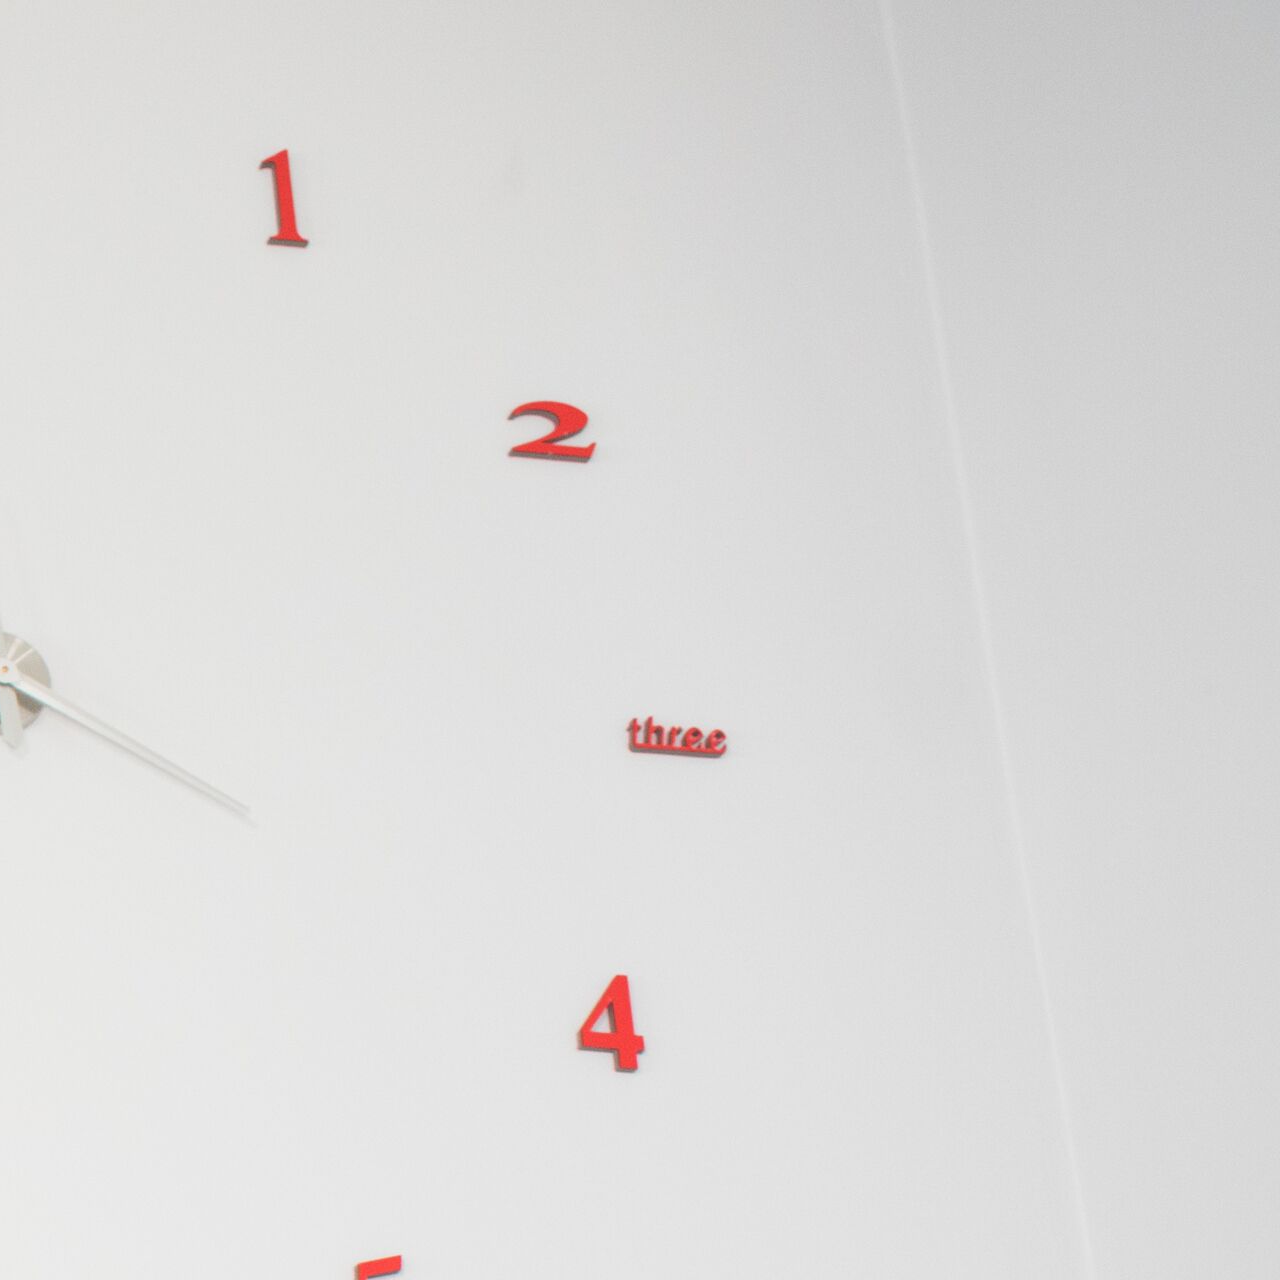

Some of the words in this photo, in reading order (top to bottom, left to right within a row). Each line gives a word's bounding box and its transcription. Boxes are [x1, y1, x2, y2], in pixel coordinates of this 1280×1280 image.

[259, 148, 309, 249] 1
[507, 400, 597, 463] 2
[626, 715, 728, 759] three
[577, 974, 646, 1073] 4
